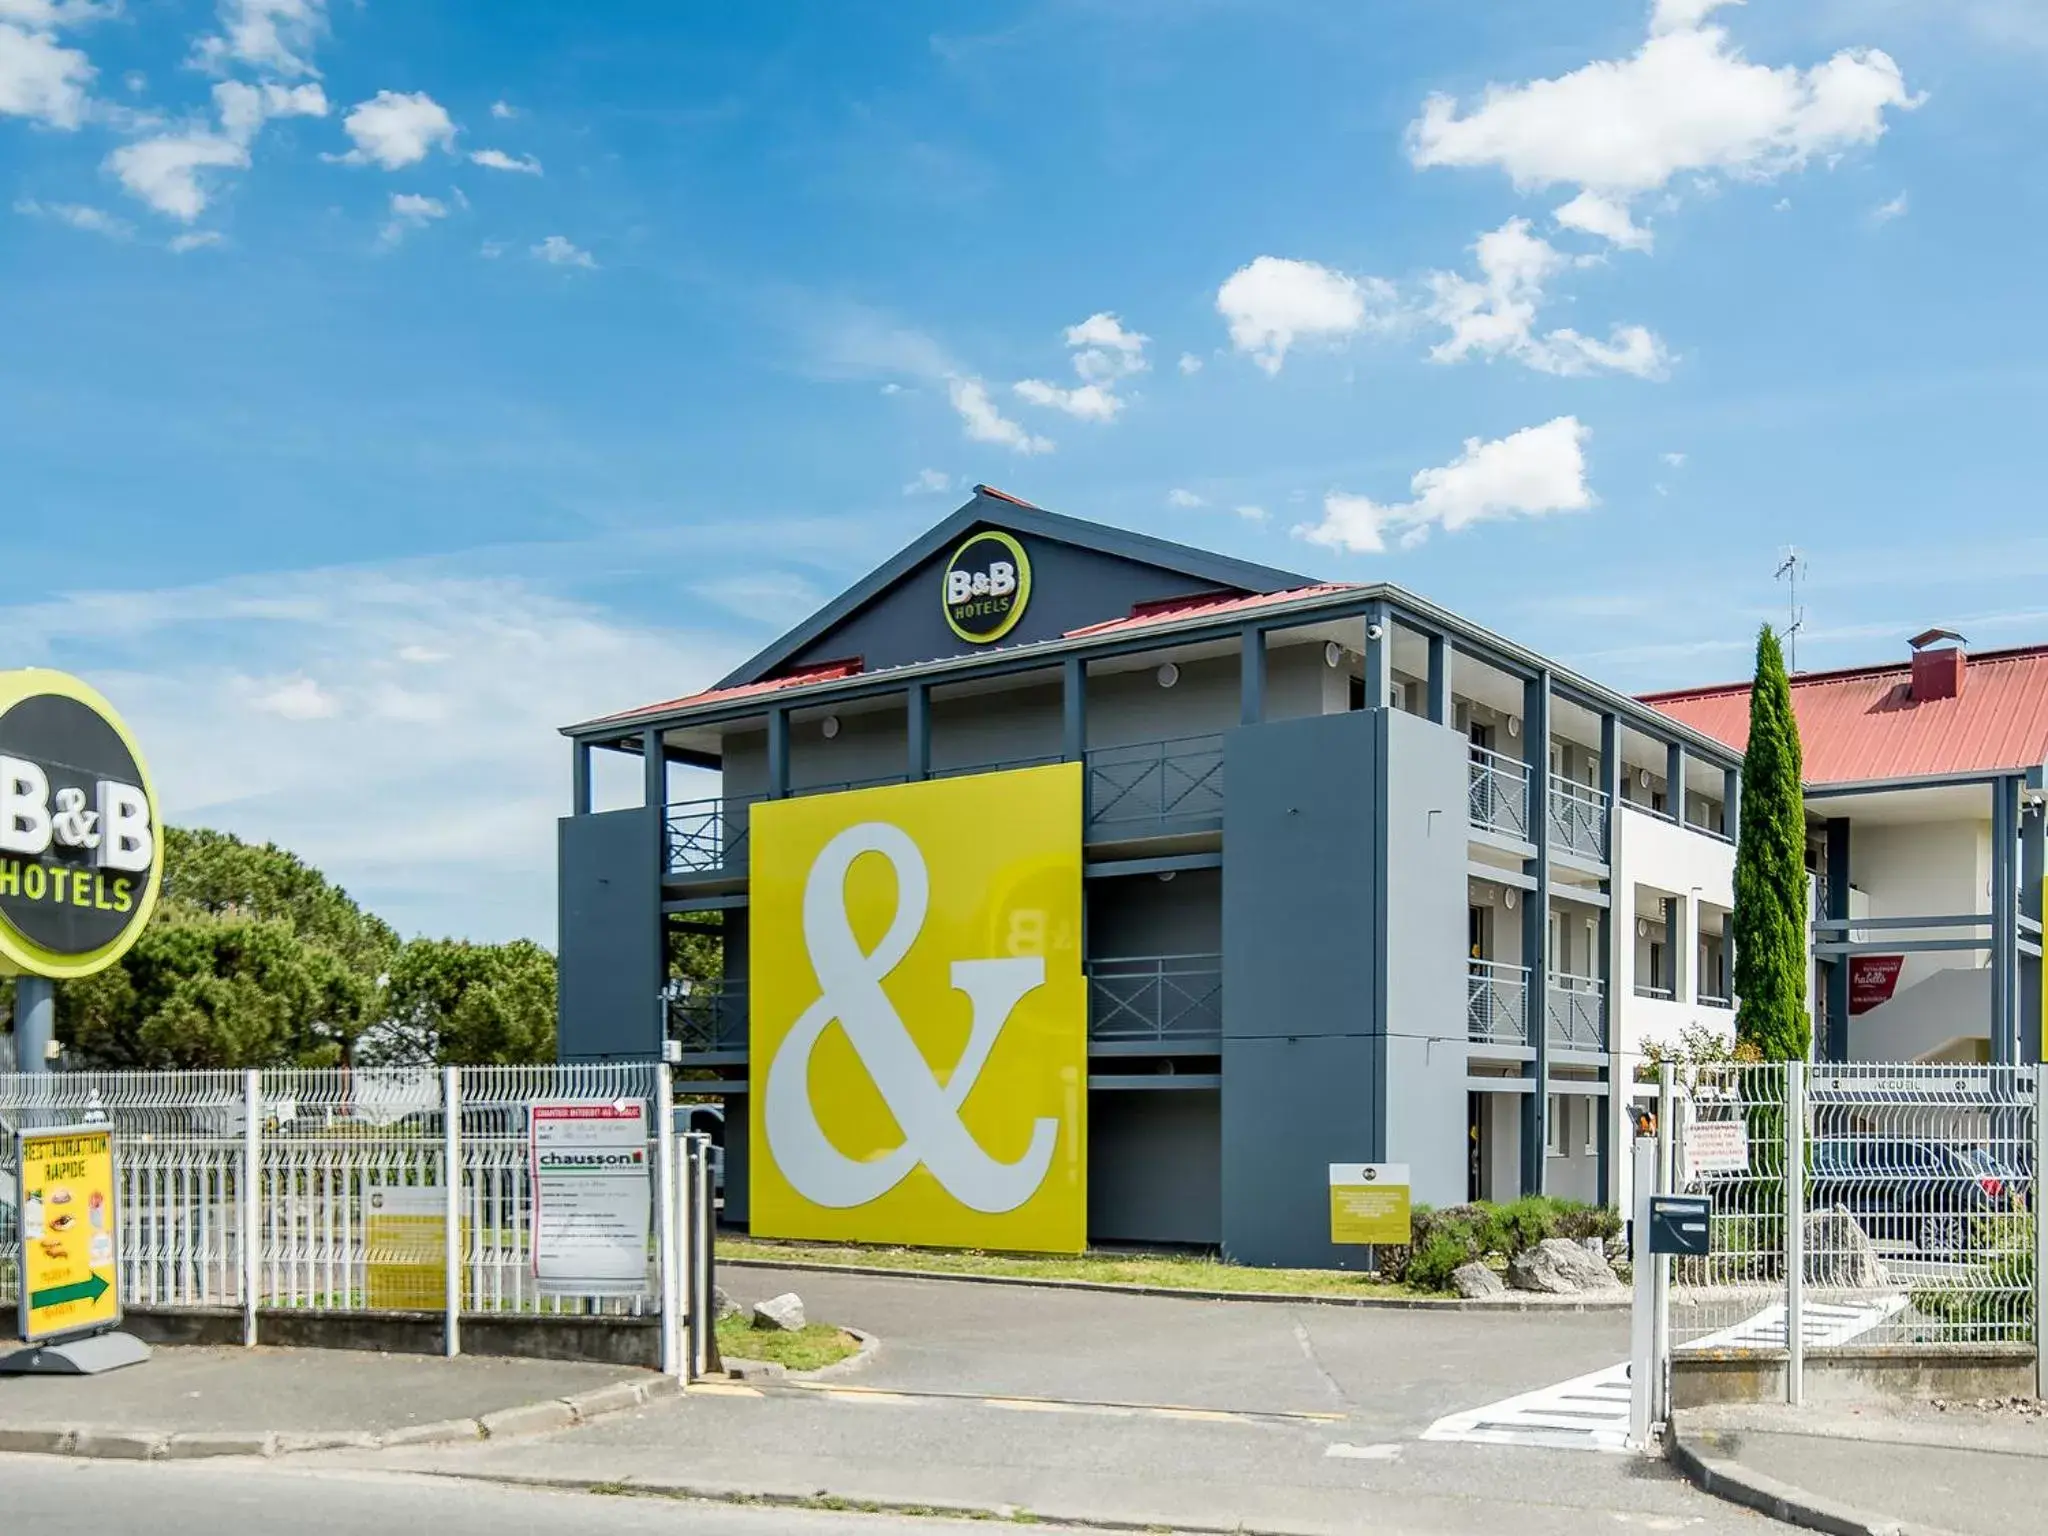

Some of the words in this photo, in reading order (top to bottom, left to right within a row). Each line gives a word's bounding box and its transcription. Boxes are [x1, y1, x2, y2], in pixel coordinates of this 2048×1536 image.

[948, 561, 1017, 605] B&B
[955, 598, 1010, 619] HOTELS
[0, 755, 154, 872] B&B
[0, 858, 133, 913] HOTELS
[765, 822, 1059, 1214] &
[45, 1160, 86, 1181] RAPIDE
[540, 1151, 631, 1165] chausson
